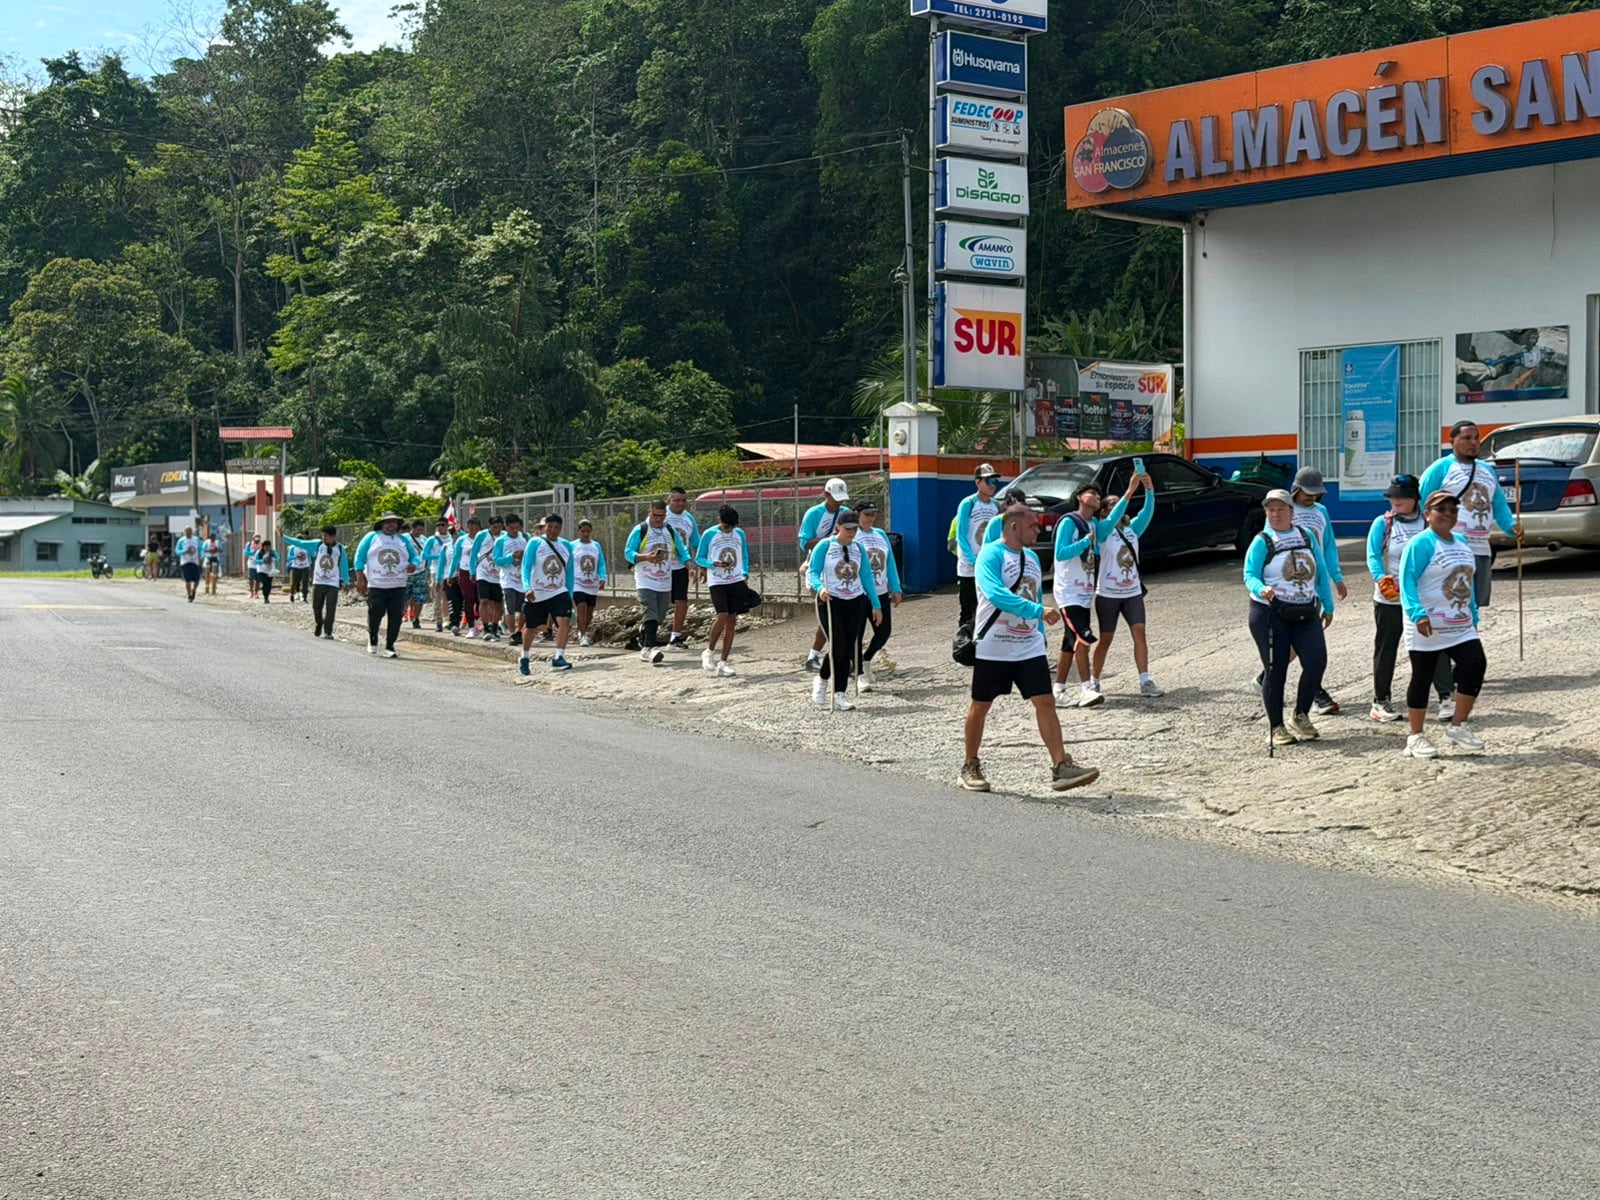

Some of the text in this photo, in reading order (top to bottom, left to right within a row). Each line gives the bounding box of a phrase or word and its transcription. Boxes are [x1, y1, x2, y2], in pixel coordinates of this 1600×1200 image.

[953, 4, 1024, 25] TEL: 2751-0195
[964, 52, 1020, 74] Husqvarna
[951, 117, 990, 129] SUMINISTROS
[1164, 48, 1600, 183] ALMACÉN SAN
[1094, 142, 1145, 157] Almacenes
[1073, 155, 1146, 178] SAN FRANCISCO
[977, 242, 1014, 254] AMANCO
[975, 256, 1010, 269] wavin
[954, 317, 1017, 357] SUR
[1104, 380, 1136, 392] espacio
